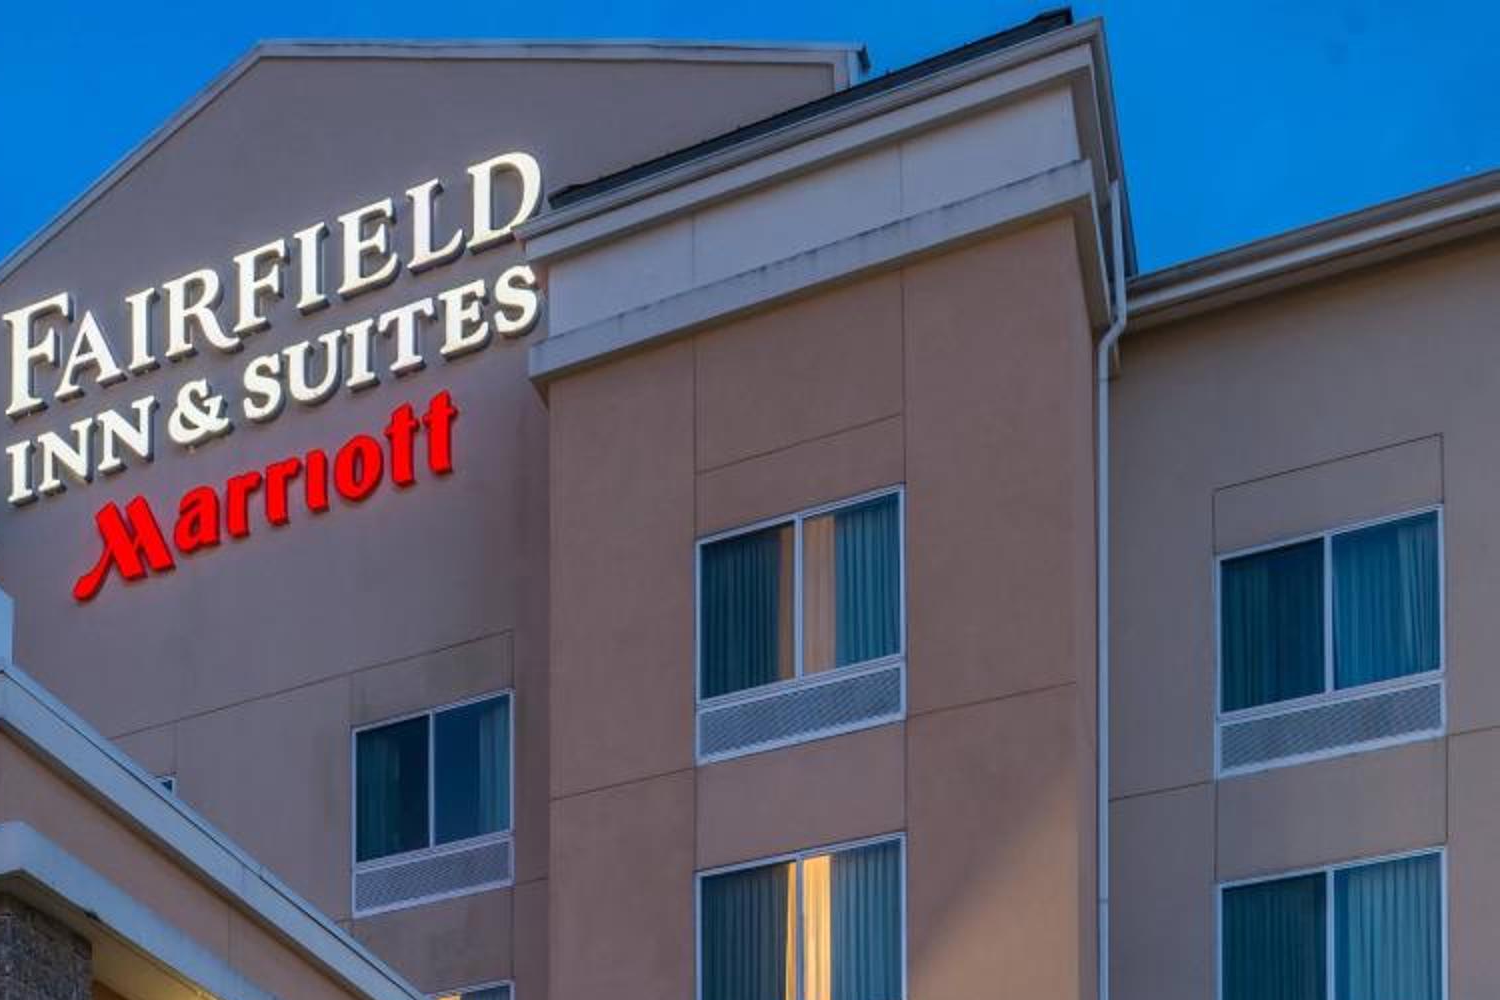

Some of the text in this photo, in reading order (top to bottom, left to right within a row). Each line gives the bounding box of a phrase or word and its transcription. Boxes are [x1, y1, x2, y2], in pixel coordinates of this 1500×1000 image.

[2, 151, 542, 418] FAIRFIELD
[6, 265, 541, 505] INN & SUITES
[73, 390, 458, 602] Marriott
